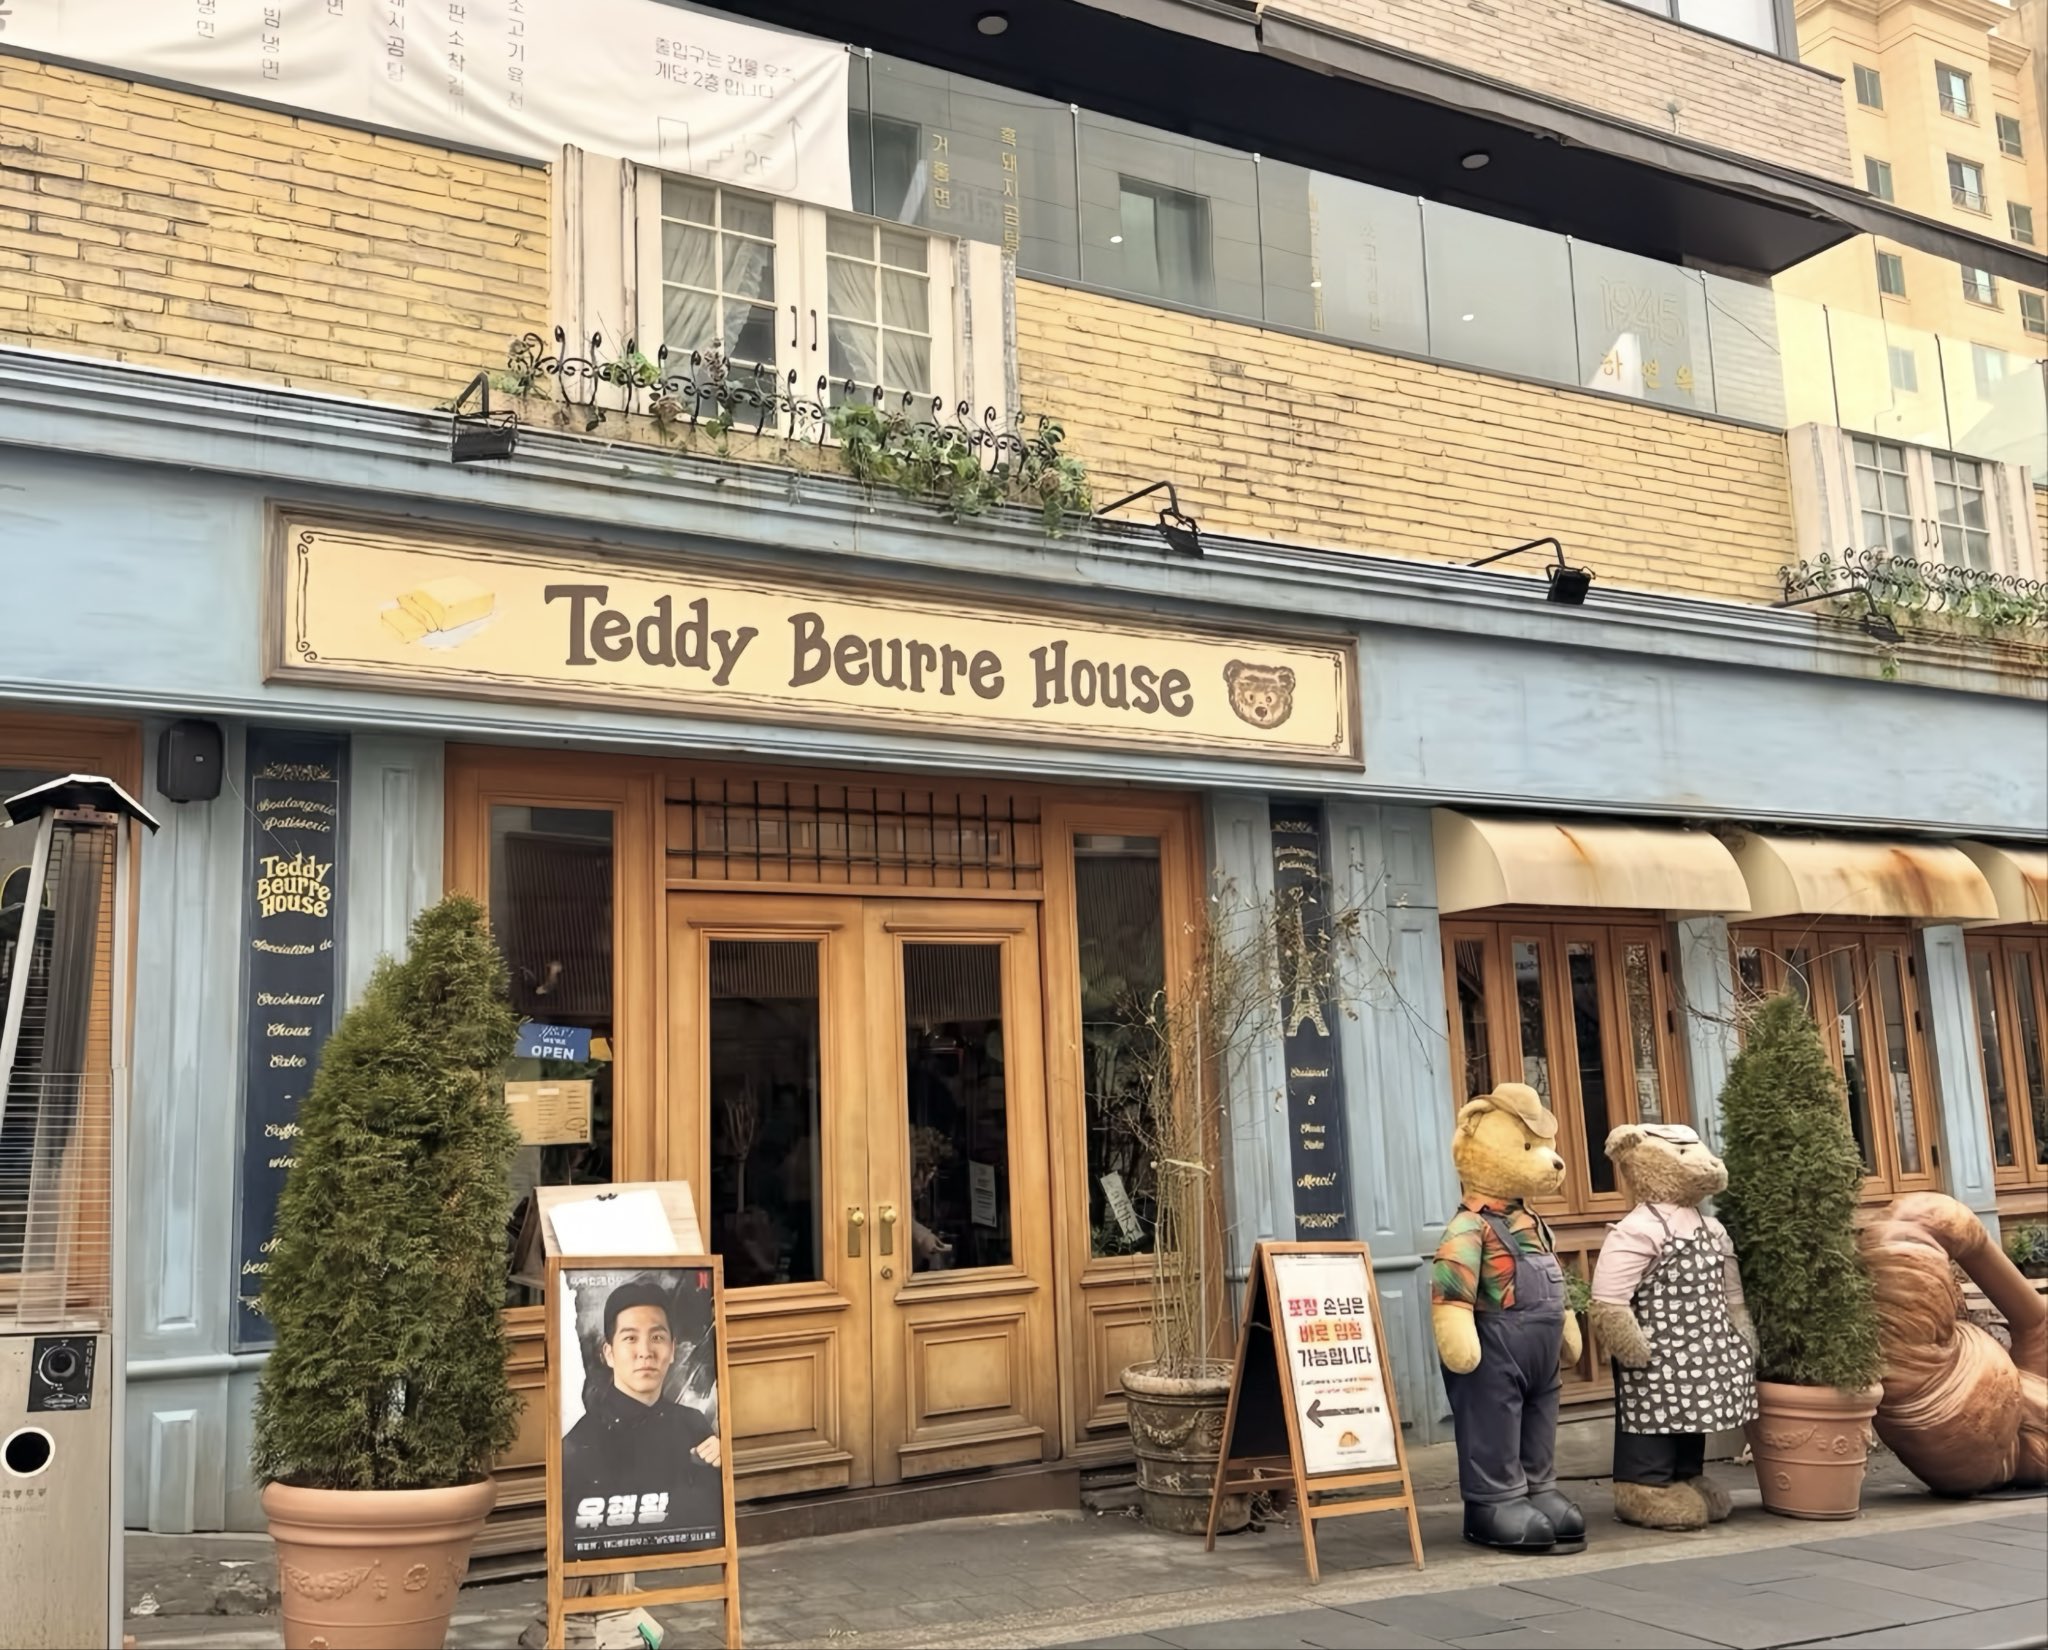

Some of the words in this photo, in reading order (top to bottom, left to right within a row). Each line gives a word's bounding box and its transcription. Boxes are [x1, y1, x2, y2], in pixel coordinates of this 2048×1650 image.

[655, 60, 688, 85] 계단
[543, 584, 759, 687] Teddy
[786, 611, 1006, 701] Beurre
[1029, 639, 1195, 718] House
[259, 851, 334, 883] Teddy
[256, 876, 332, 902] Beurre
[256, 992, 325, 1006] Croissant
[266, 1023, 312, 1037] Choux
[531, 1045, 575, 1061] OPEN
[1287, 1298, 1318, 1317] 포장
[1323, 1296, 1365, 1316] 손님은
[1299, 1324, 1330, 1343] 바로
[1297, 1345, 1372, 1368] 가능합니다
